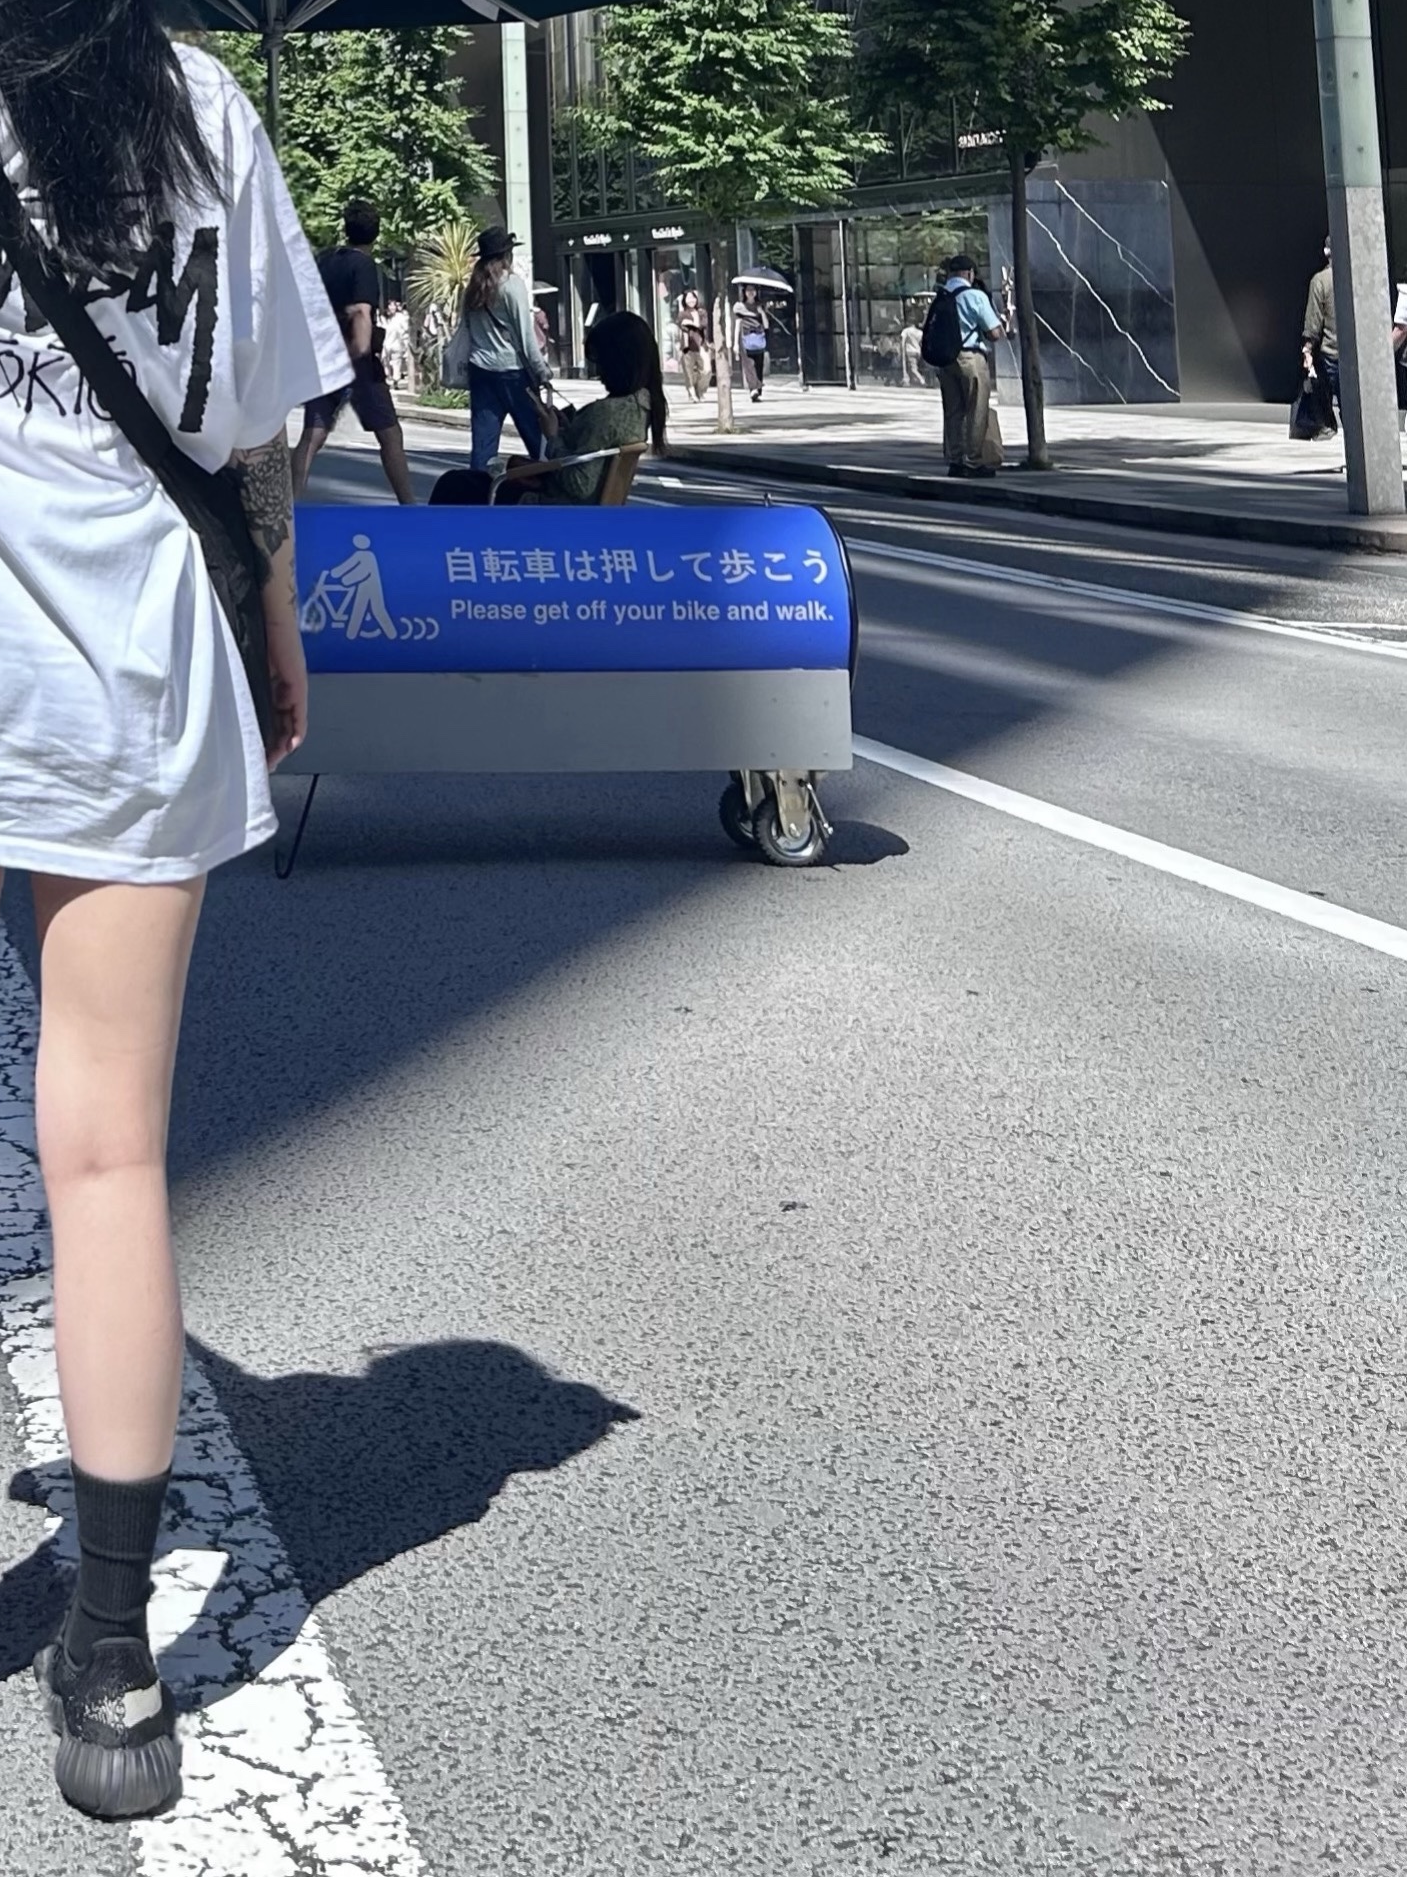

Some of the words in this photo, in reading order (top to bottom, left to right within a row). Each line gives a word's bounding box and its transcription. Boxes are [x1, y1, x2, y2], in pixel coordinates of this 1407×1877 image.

[445, 547, 829, 585] 自転車は押して歩こう
[451, 599, 527, 621] Please
[533, 600, 570, 625] get
[576, 599, 608, 621] off
[613, 603, 666, 625] your
[672, 599, 721, 621] bike
[727, 600, 769, 621] and
[775, 600, 834, 621] walk.
